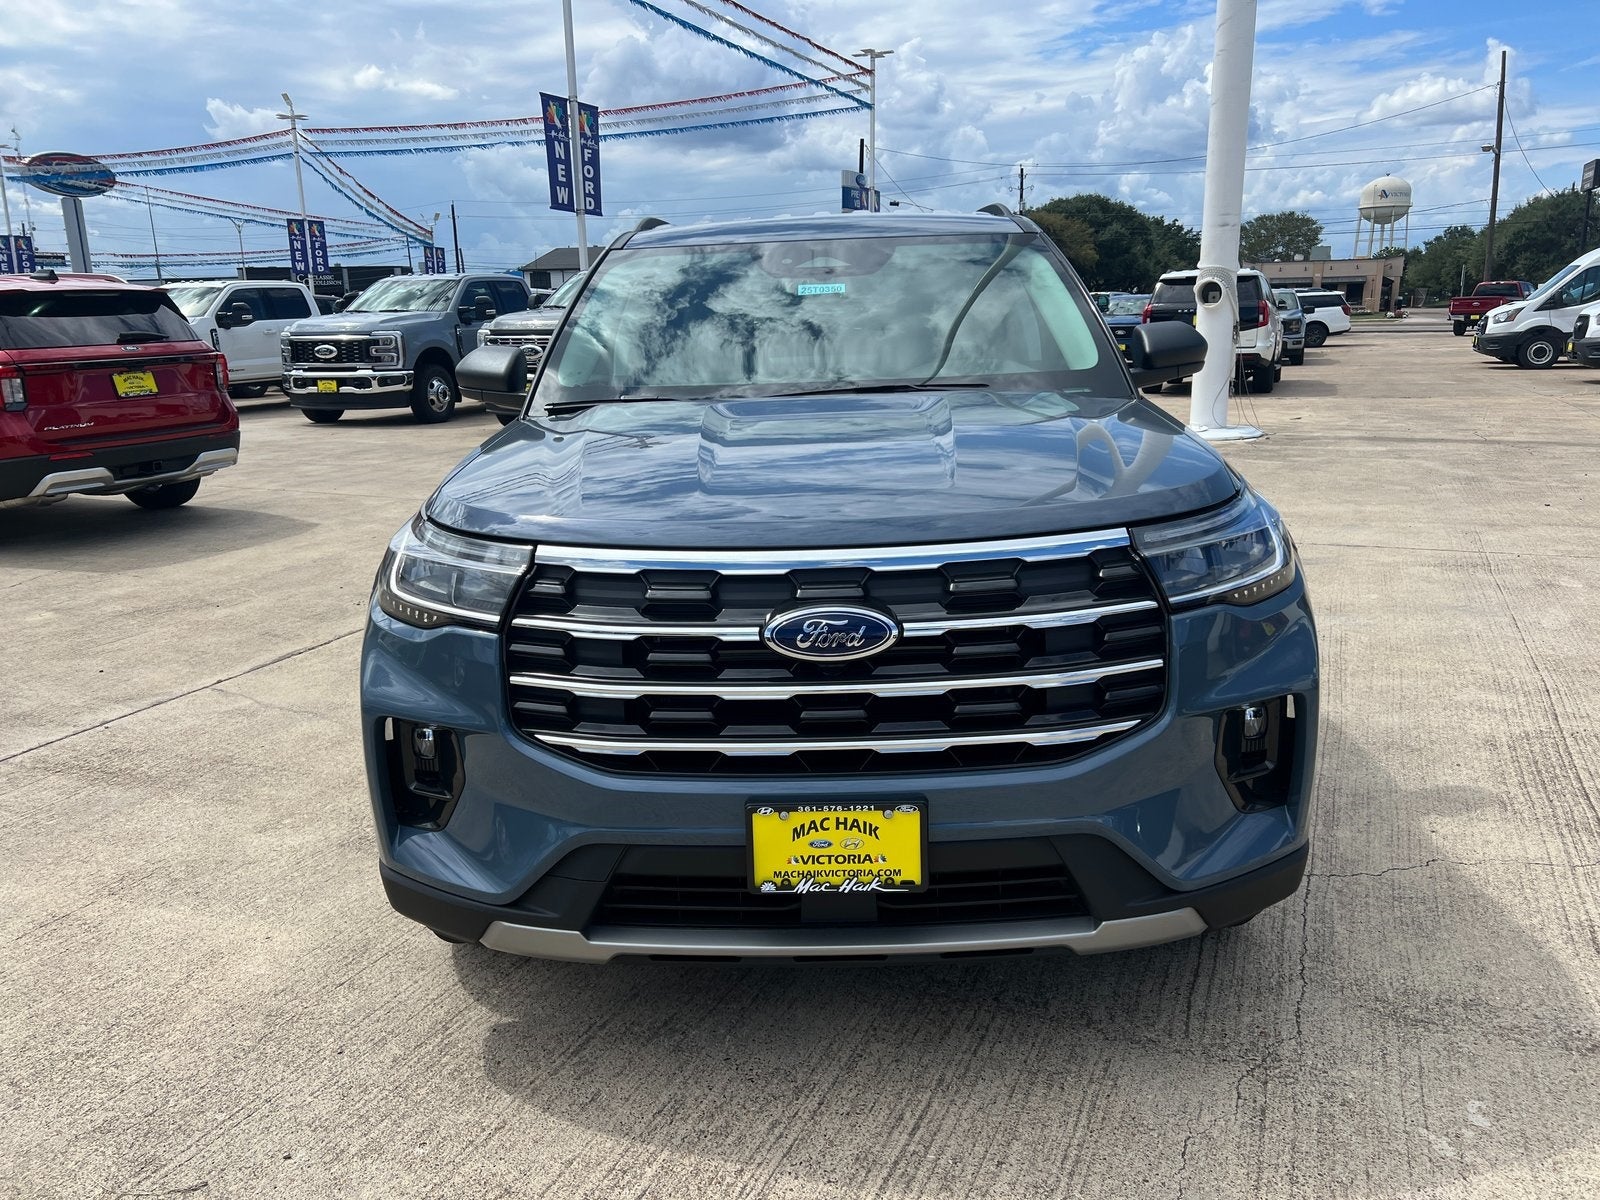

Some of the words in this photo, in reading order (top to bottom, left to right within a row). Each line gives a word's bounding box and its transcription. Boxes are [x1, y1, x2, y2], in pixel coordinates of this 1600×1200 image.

[554, 141, 568, 205] NEW
[583, 148, 595, 210] FORD
[0, 253, 10, 274] NE
[22, 254, 31, 274] FOR
[293, 240, 305, 271] NEW
[315, 241, 325, 272] FORD
[801, 285, 842, 294] 25T0350
[44, 422, 95, 431] PLATINUM
[796, 618, 867, 649] Ford
[791, 817, 831, 842] MAC
[835, 816, 881, 841] HAIK
[812, 840, 830, 848] Ford
[800, 853, 874, 865] VICTORIA
[773, 868, 902, 879] MACHAIKVICTORIA.COM
[793, 877, 836, 894] Mac
[838, 876, 886, 894] Haik
